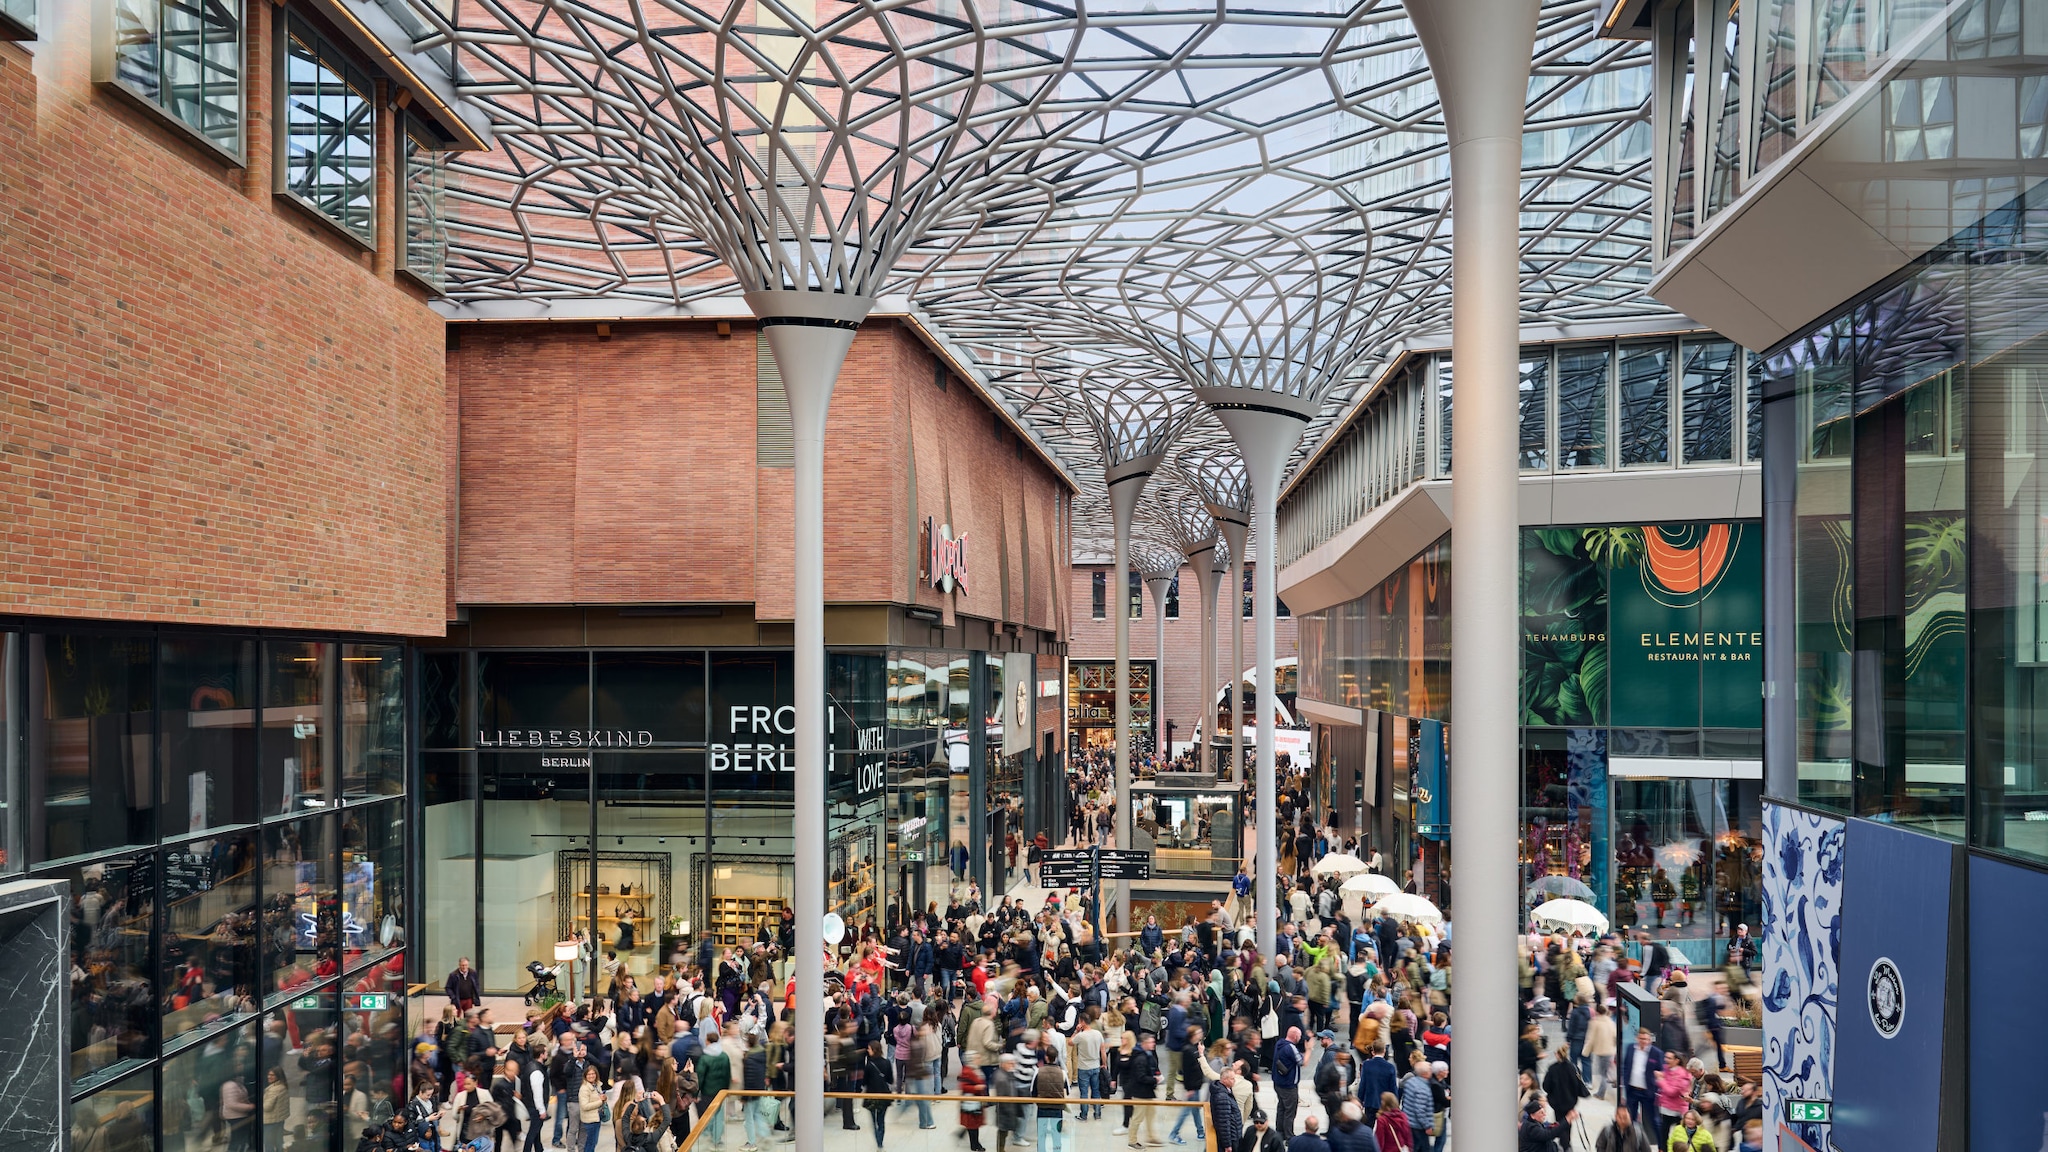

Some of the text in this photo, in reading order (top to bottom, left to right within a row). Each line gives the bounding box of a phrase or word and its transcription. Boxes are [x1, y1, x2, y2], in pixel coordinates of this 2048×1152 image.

[1641, 632, 1762, 646] ELEMENTE
[1648, 653, 1751, 661] RESTAURANT & BAR
[730, 705, 834, 734] FRO
[480, 730, 653, 747] LIEBESKIND
[857, 726, 885, 756] WITH
[541, 757, 591, 768] BERLIN
[711, 743, 834, 772] BERL
[857, 761, 884, 794] LOVE
